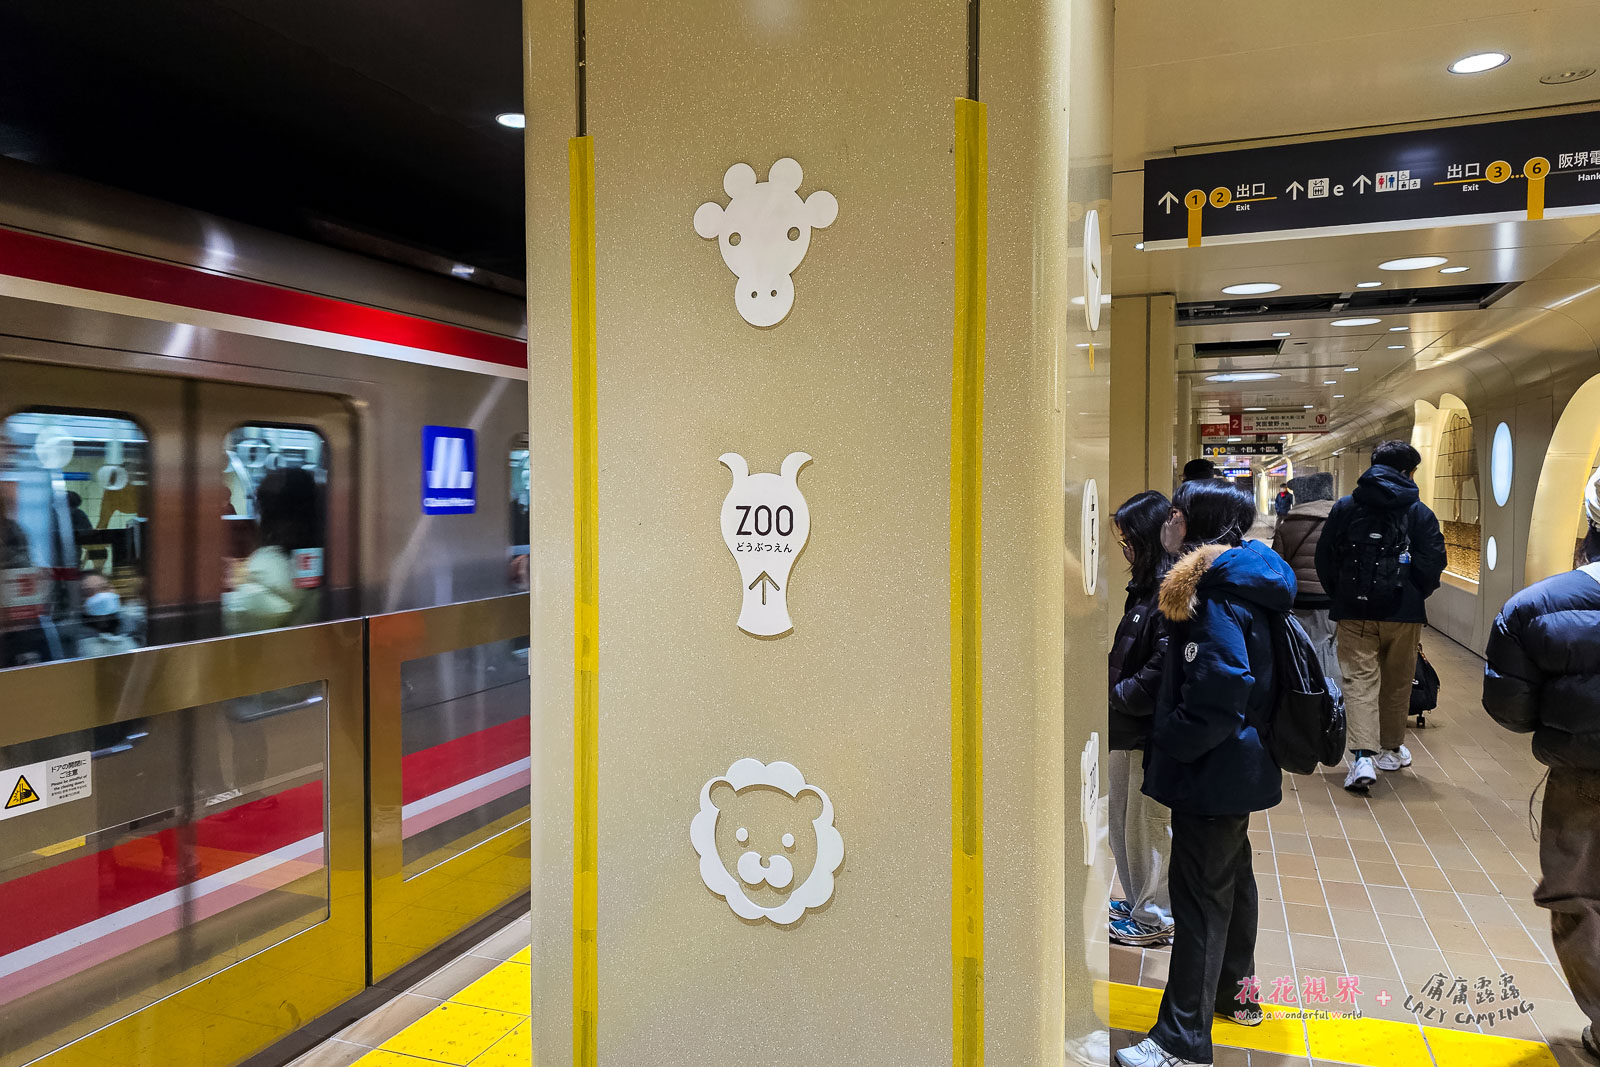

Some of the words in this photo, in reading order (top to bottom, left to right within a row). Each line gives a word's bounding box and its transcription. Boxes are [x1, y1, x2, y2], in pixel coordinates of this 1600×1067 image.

[1447, 163, 1480, 179] 出口
[1236, 183, 1265, 198] 出口
[1333, 182, 1344, 196] e
[1462, 184, 1479, 192] Exit
[1235, 203, 1250, 212] Exit
[1232, 419, 1239, 428] 2
[735, 505, 794, 536] ZOO
[736, 542, 793, 553] どうぶつえん
[52, 760, 87, 773] ドアの開閉に
[60, 769, 78, 778] ご注意
